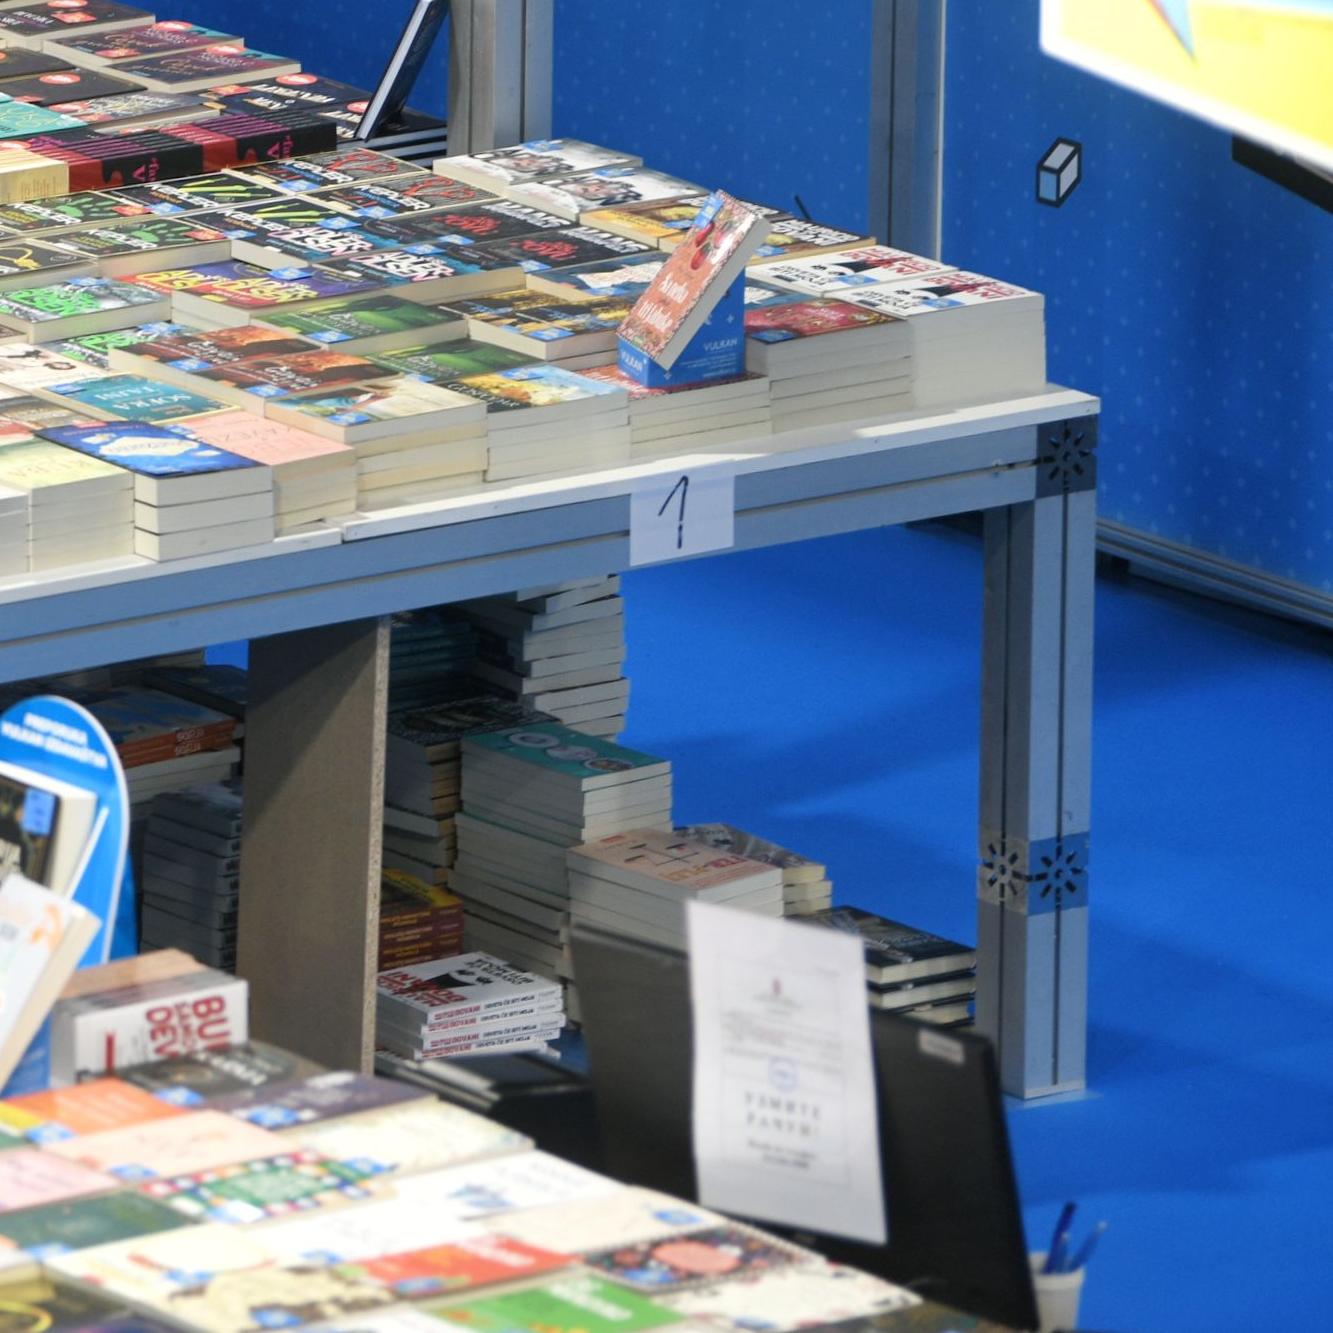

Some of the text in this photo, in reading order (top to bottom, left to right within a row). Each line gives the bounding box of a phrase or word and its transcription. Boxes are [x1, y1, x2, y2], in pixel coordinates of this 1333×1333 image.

[353, 185, 432, 211] KEPLER
[9, 202, 82, 225] KEPLER
[87, 229, 158, 250] KEPLER
[657, 474, 690, 550] 1
